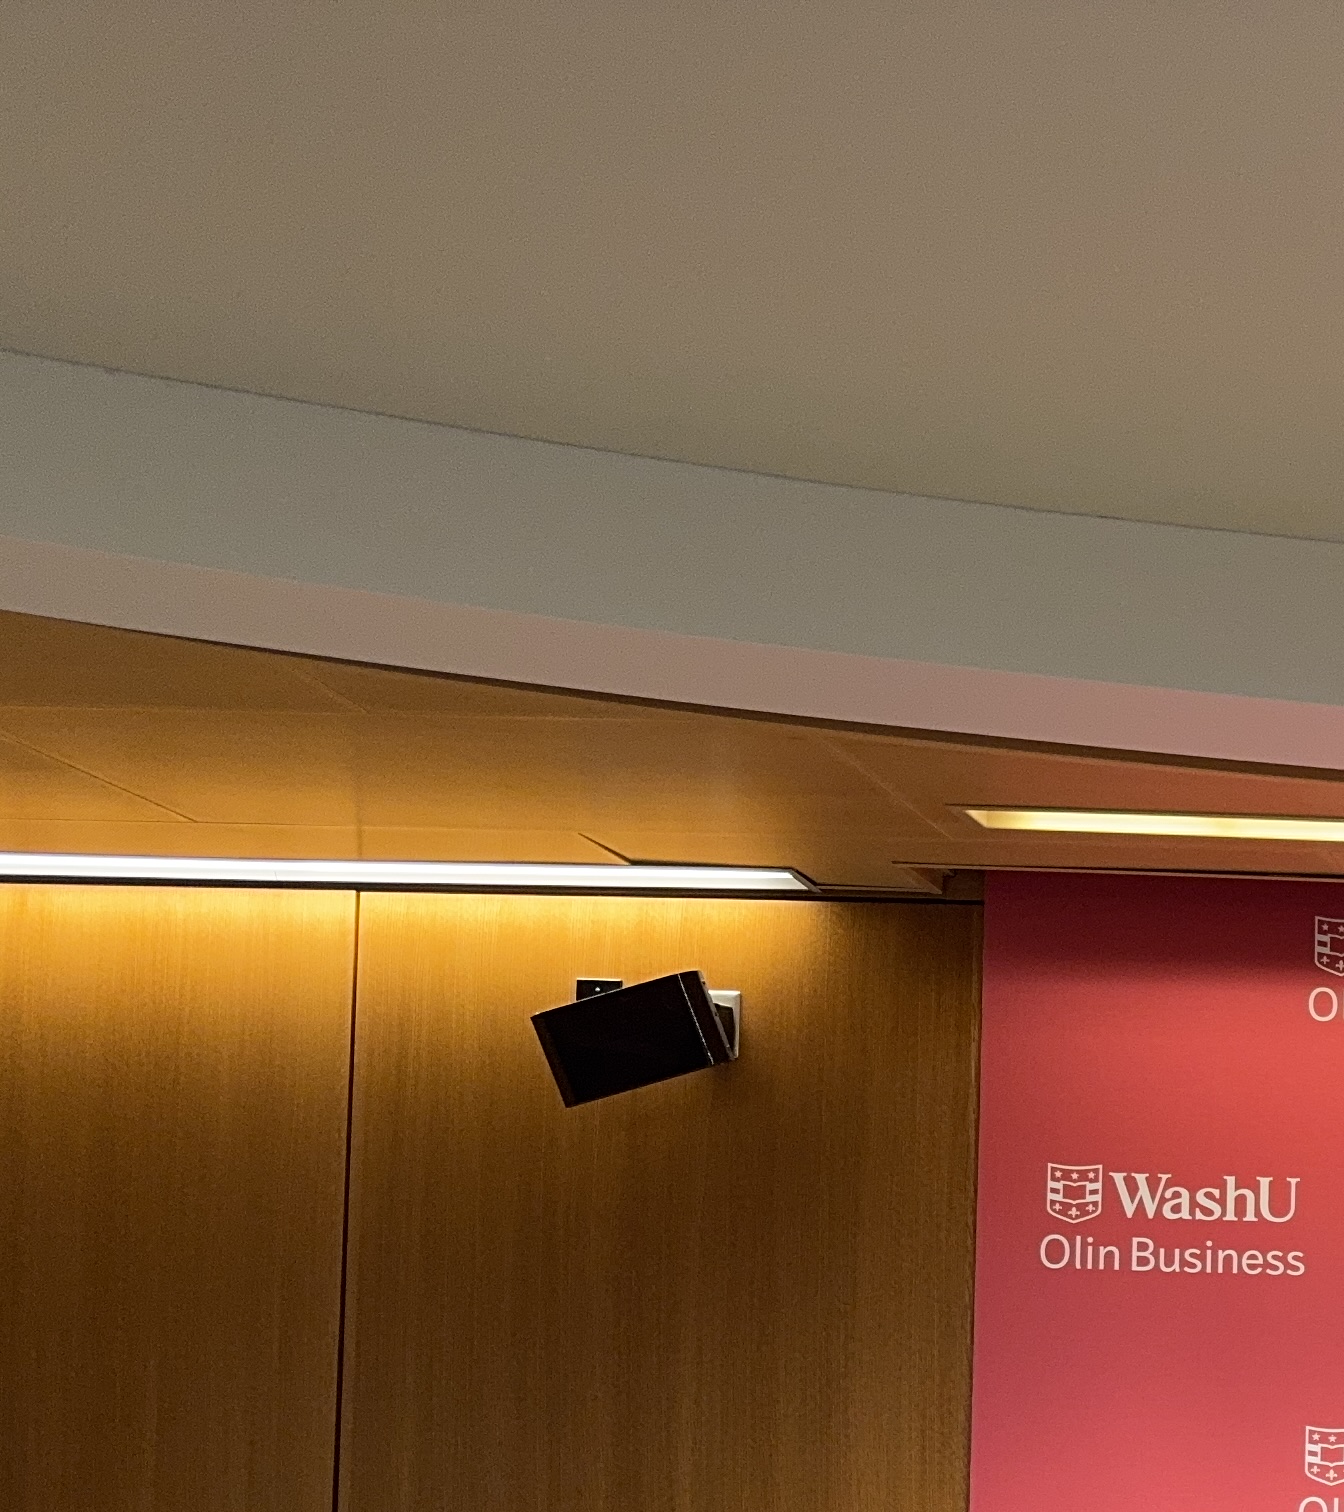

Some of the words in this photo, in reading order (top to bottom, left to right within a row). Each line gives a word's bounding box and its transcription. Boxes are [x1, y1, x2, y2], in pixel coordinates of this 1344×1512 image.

[1108, 1171, 1301, 1223] WashU
[1039, 1233, 1120, 1271] Olin
[1131, 1236, 1305, 1276] Business
